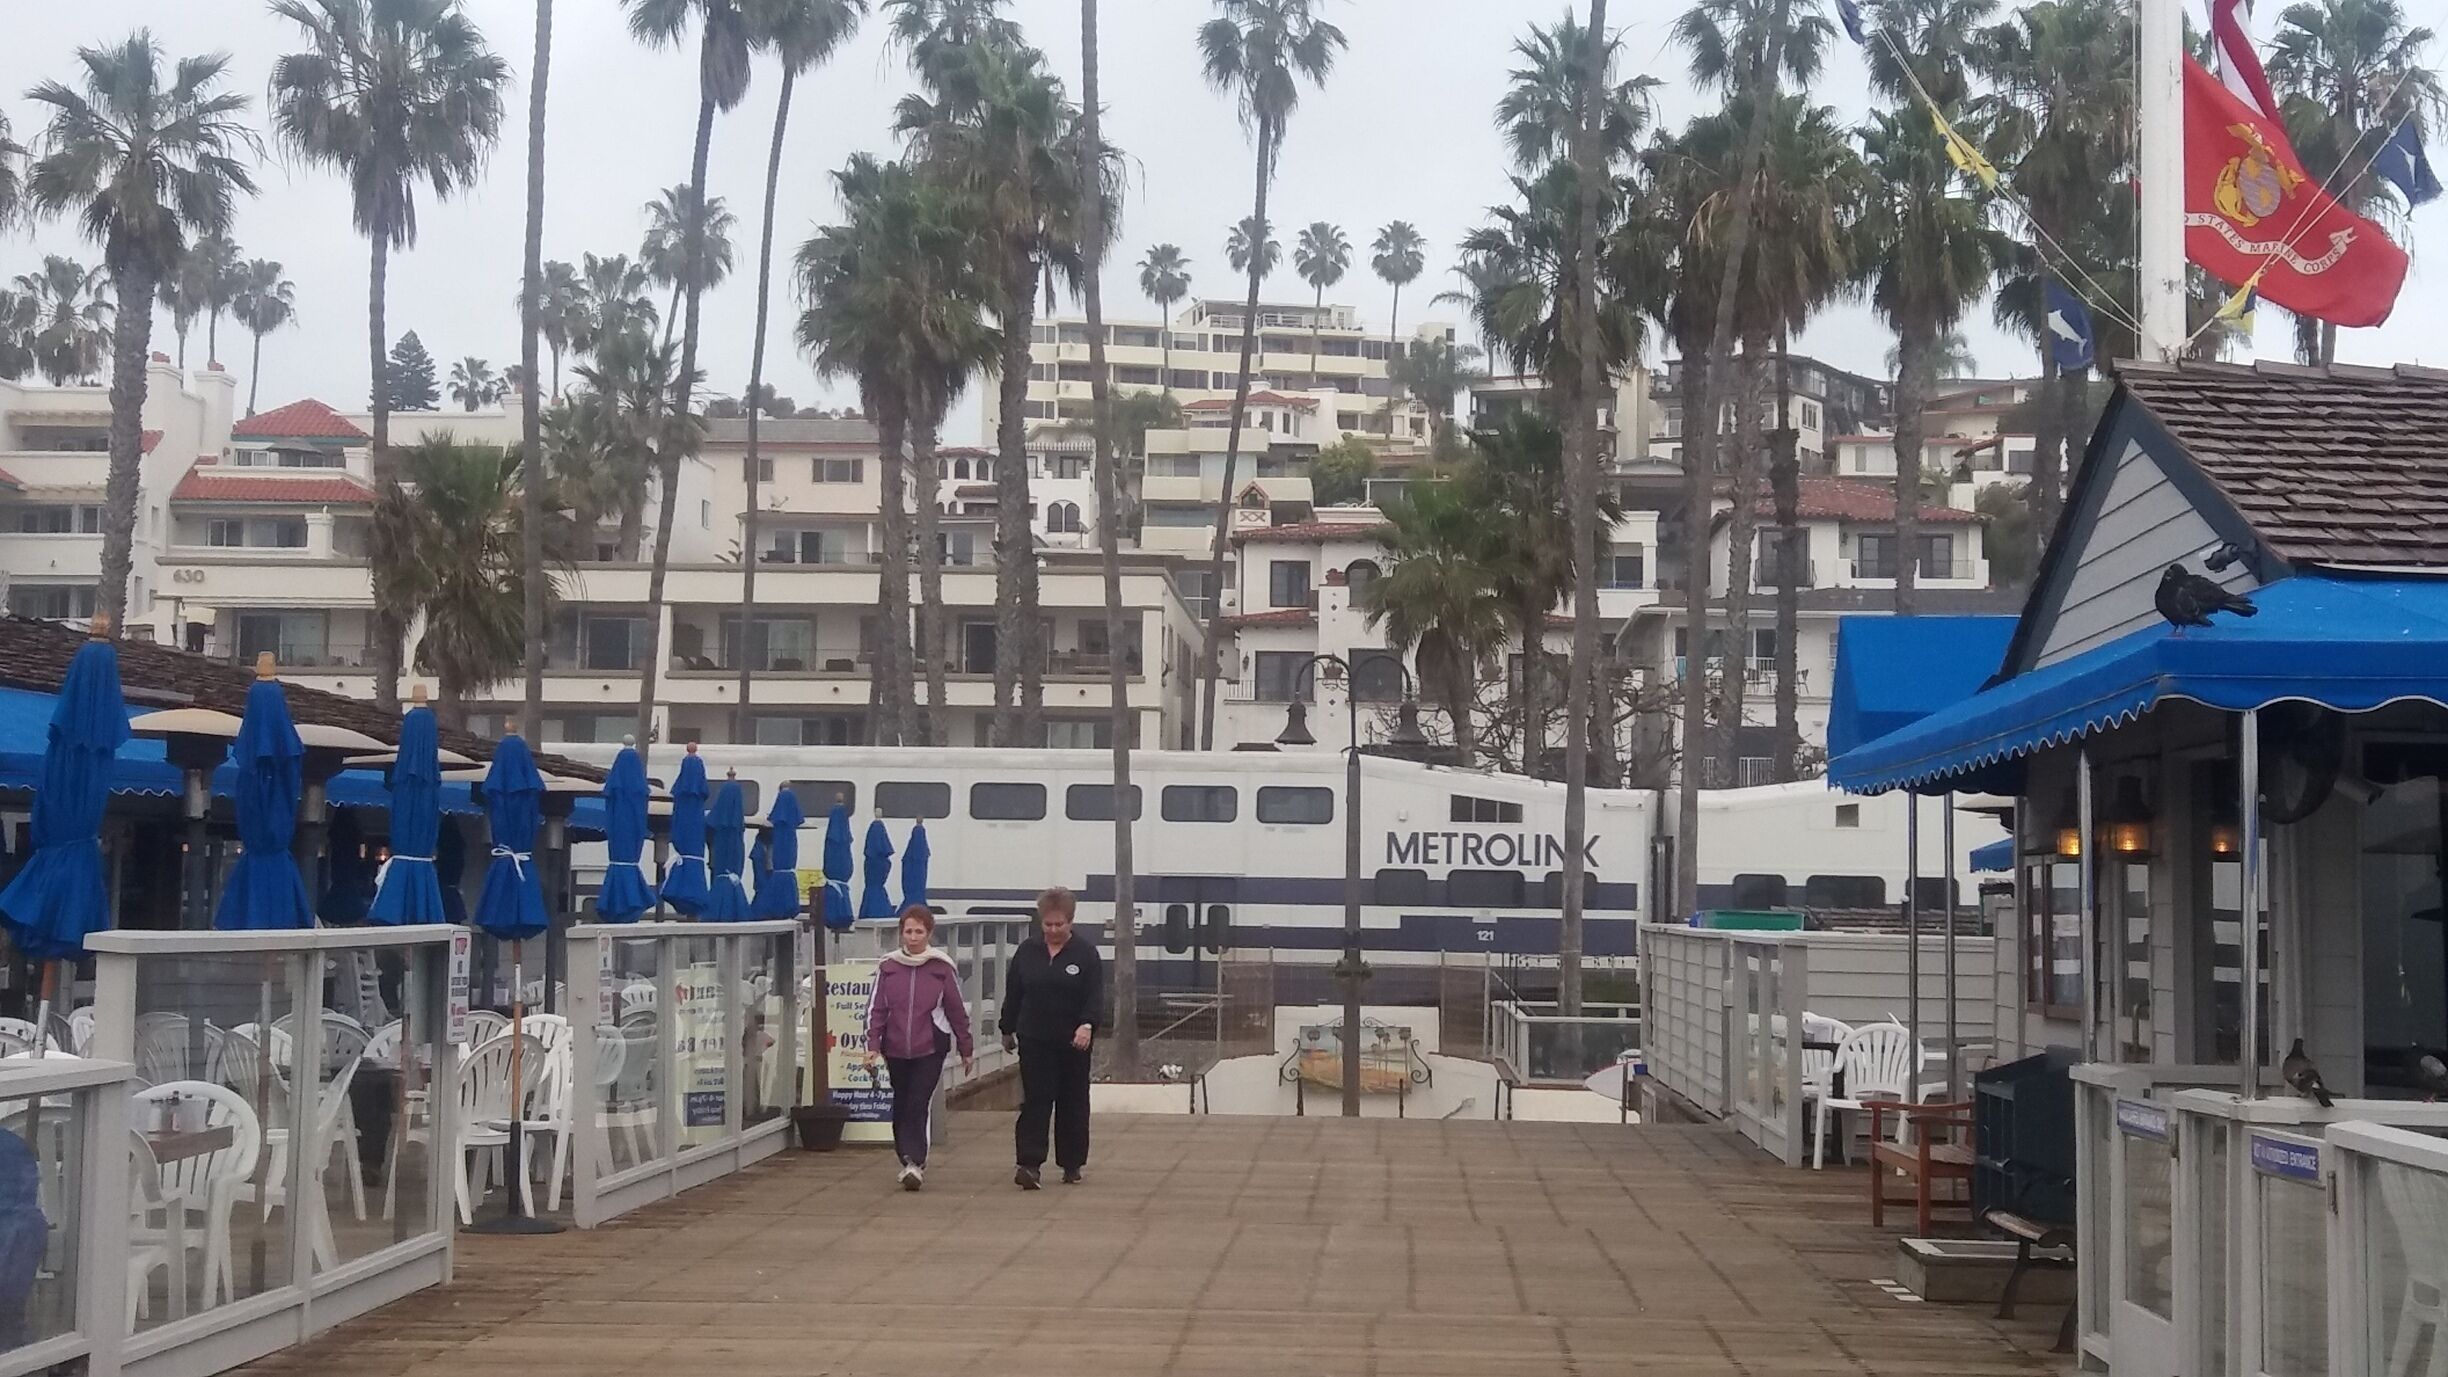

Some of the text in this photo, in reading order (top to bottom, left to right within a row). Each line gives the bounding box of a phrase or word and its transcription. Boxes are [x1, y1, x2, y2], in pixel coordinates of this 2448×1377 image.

[2198, 214, 2244, 249] STATES
[2249, 241, 2298, 266] MARINE
[2303, 246, 2342, 273] CORPS
[173, 569, 205, 583] 630
[1386, 831, 1601, 868] METROLINK
[1476, 930, 1495, 941] 121
